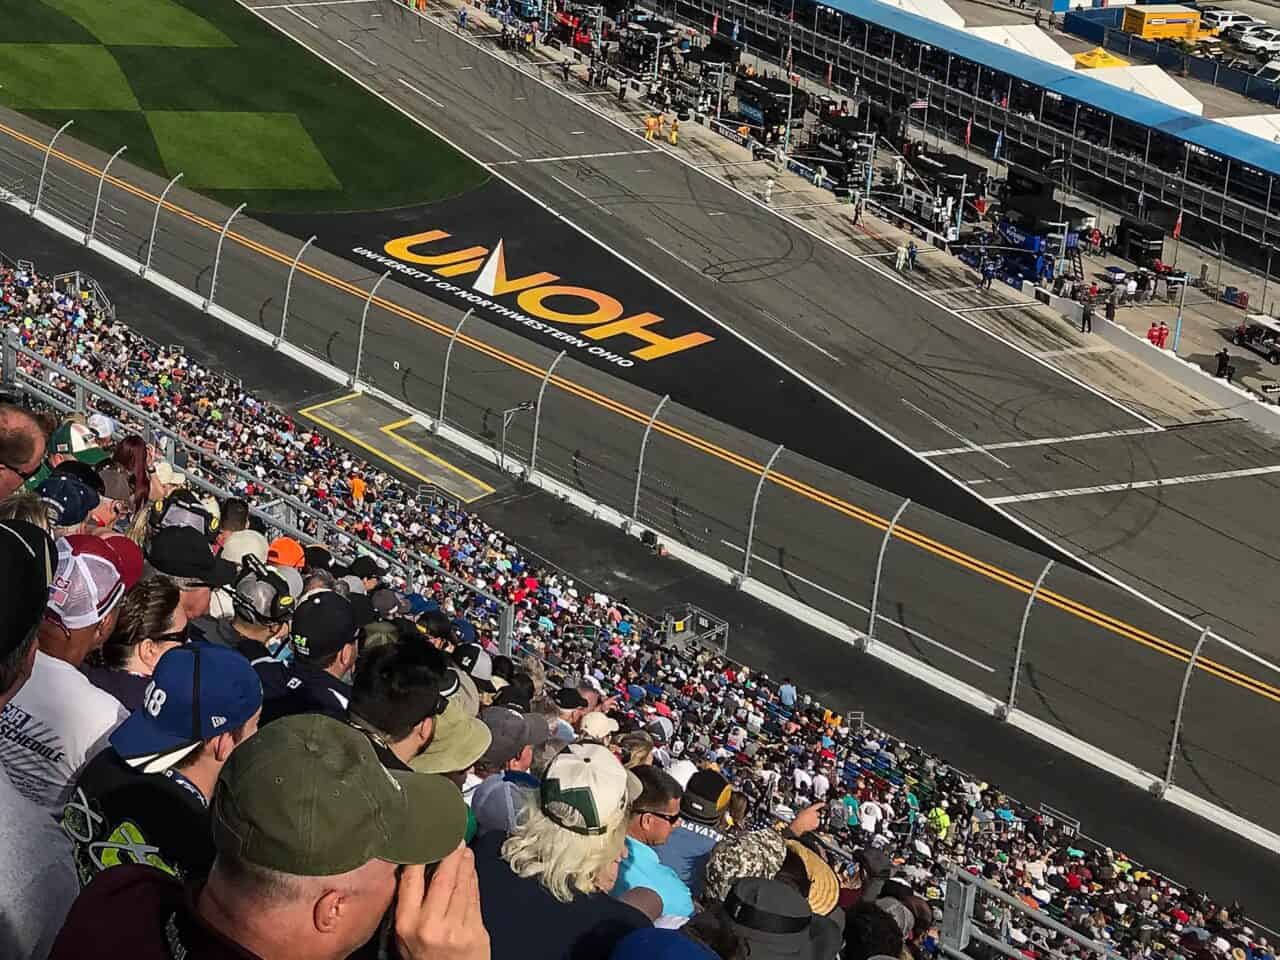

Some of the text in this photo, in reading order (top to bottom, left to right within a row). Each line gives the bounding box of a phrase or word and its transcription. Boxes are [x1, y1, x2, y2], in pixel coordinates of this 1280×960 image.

[351, 246, 635, 368] UNIVERSITY OF NORTHWESTERN OHIO
[384, 230, 716, 361] UNOH
